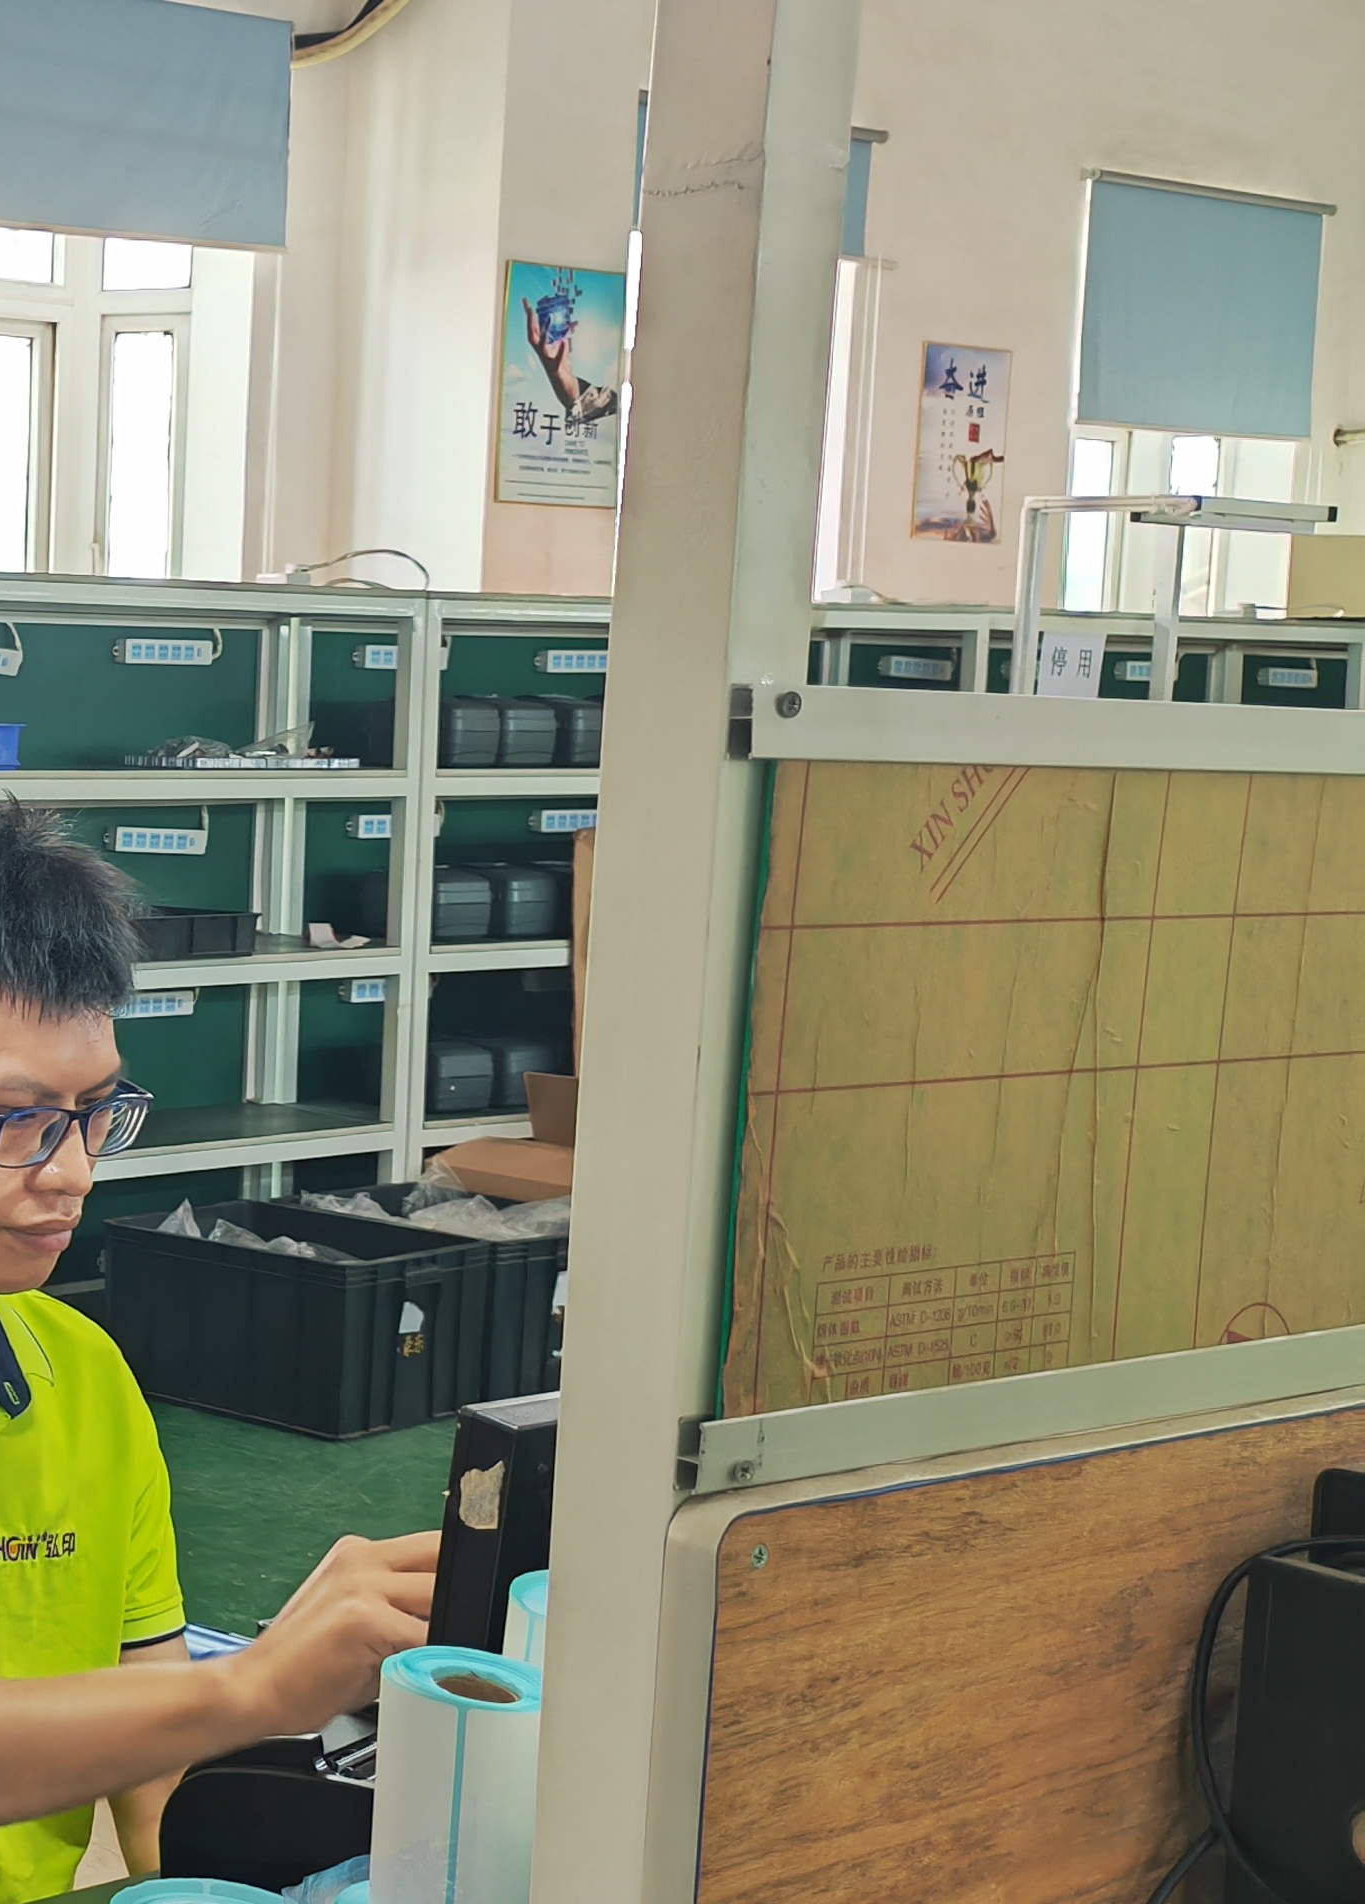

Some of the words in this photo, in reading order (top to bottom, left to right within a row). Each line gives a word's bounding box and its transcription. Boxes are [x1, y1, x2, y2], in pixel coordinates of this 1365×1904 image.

[939, 358, 990, 403] 奋进
[512, 402, 598, 446] 敢于创新
[1051, 646, 1092, 678] 停用
[910, 798, 954, 872] XIN
[951, 765, 994, 812] SH
